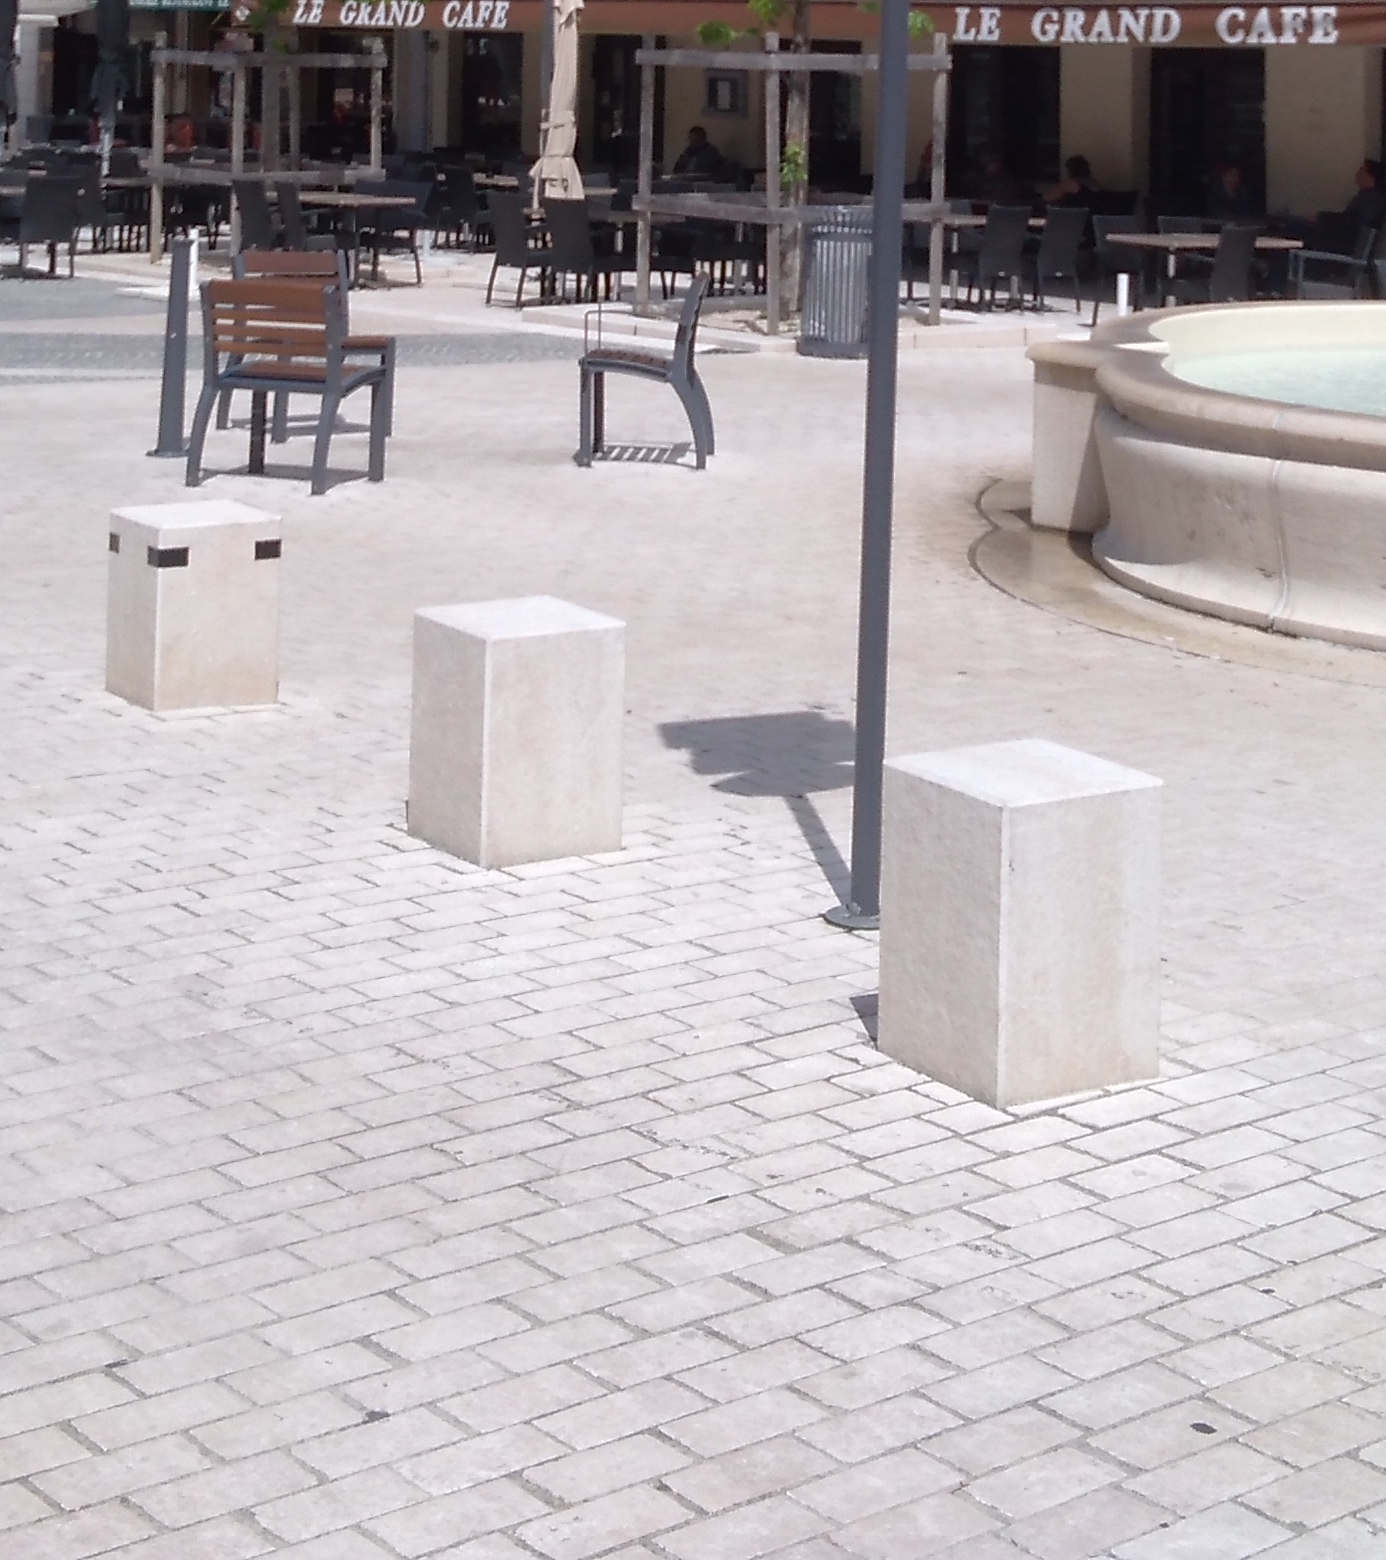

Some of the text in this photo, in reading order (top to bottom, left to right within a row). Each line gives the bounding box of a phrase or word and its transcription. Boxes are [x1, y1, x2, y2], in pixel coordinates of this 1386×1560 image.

[442, 0, 511, 29] CAFE
[953, 6, 1339, 45] LE GRAND CAFE
